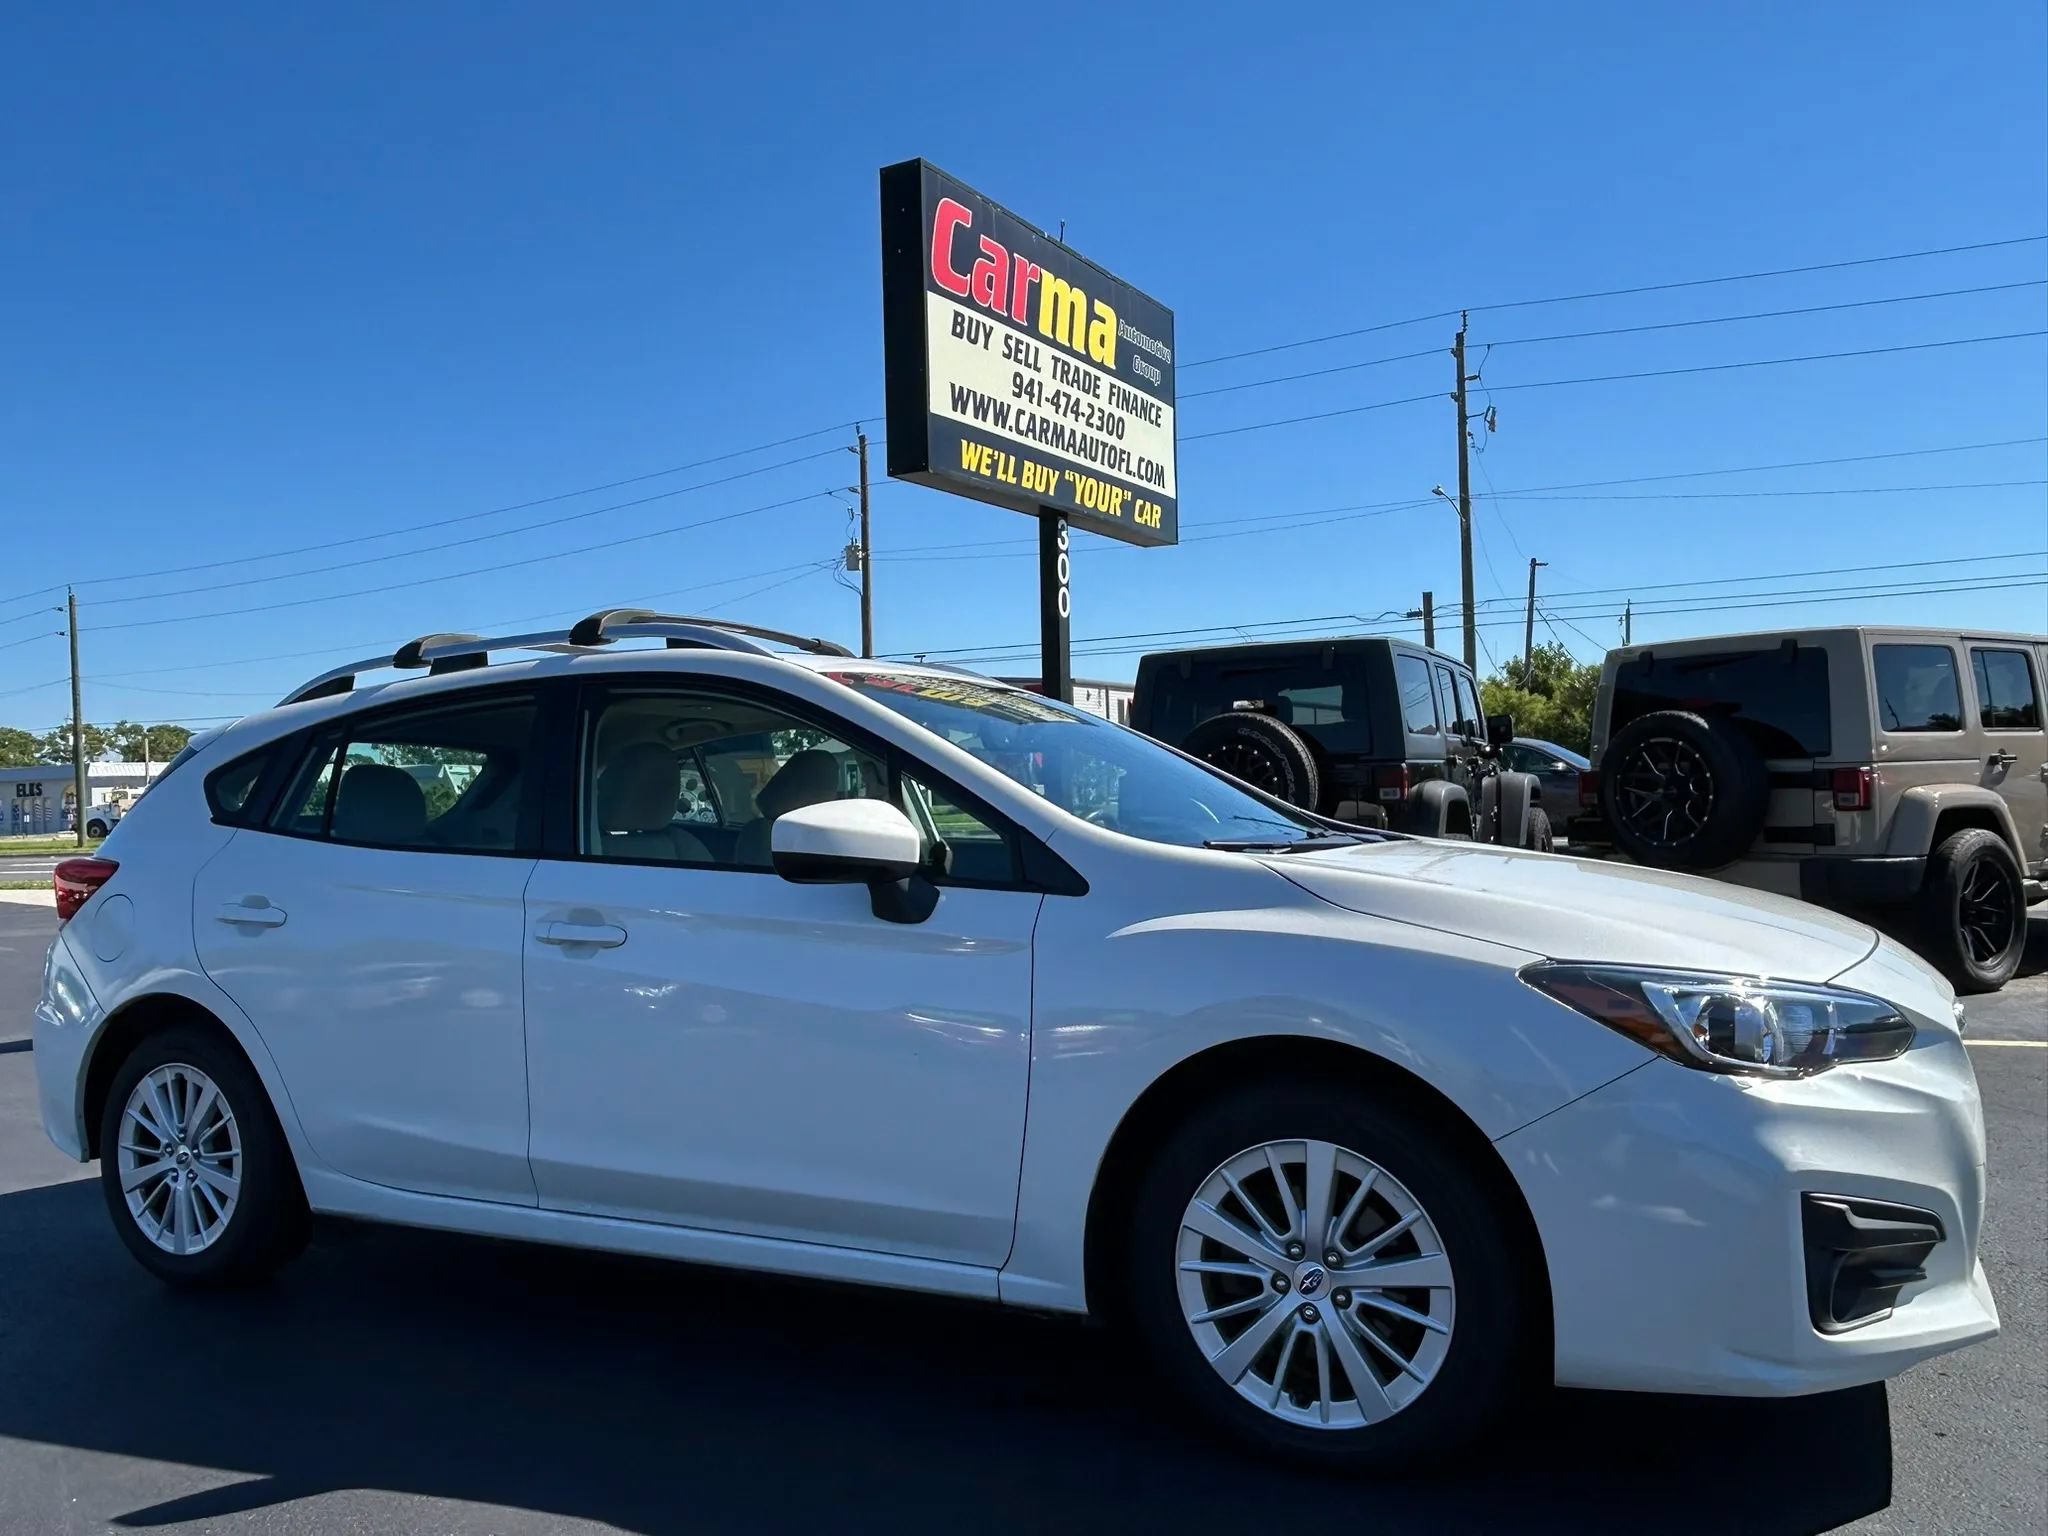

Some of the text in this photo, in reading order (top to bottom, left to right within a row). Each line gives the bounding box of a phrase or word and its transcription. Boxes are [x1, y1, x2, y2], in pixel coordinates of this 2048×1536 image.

[931, 197, 1117, 370] Carma
[951, 309, 1162, 428] BUY SELL TRADE FINANCE
[1012, 371, 1125, 440] 941-474-2300
[949, 381, 1166, 489] WWW.CARMAAUTOFL.COM
[961, 439, 1163, 529] WE'LL BUY "YOUR" CAR
[1057, 519, 1070, 618] 300
